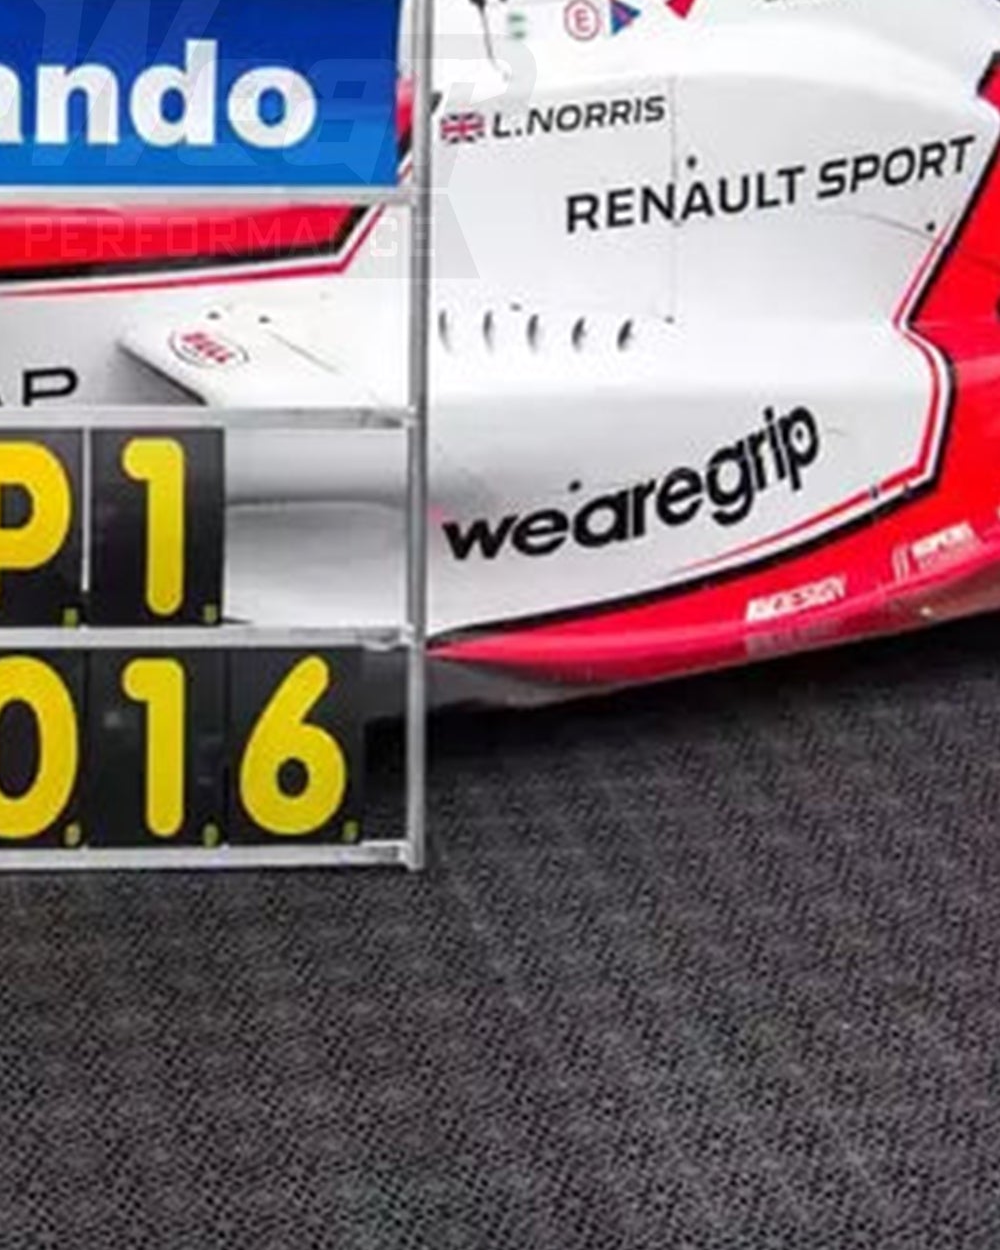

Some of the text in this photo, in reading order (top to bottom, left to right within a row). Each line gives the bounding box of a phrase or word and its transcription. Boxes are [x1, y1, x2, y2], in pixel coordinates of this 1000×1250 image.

[493, 95, 666, 139] L.NORRIS
[567, 133, 977, 234] RENAULT SPORT
[441, 405, 819, 561] wearegrip
